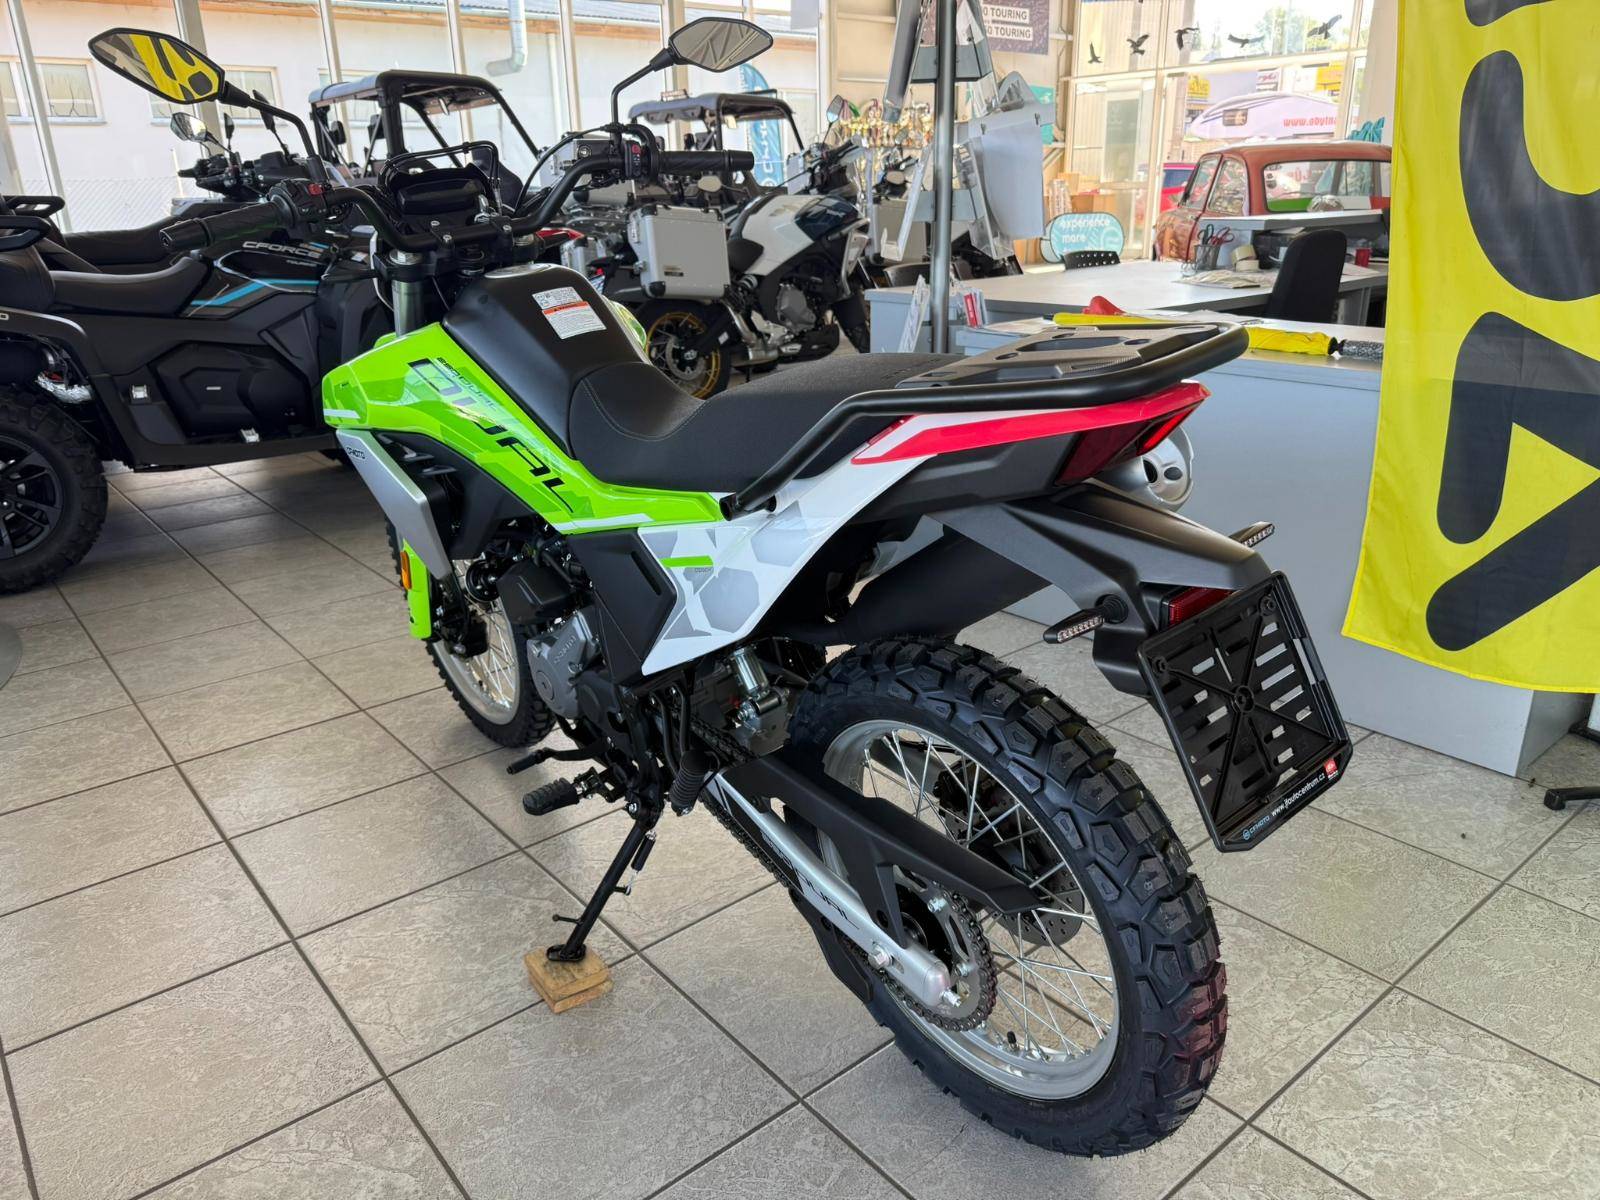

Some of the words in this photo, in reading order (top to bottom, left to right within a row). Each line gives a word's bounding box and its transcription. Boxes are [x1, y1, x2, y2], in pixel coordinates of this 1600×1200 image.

[990, 8, 1027, 20] TOURING
[994, 26, 1031, 39] TOURING
[242, 241, 321, 259] CFORCE
